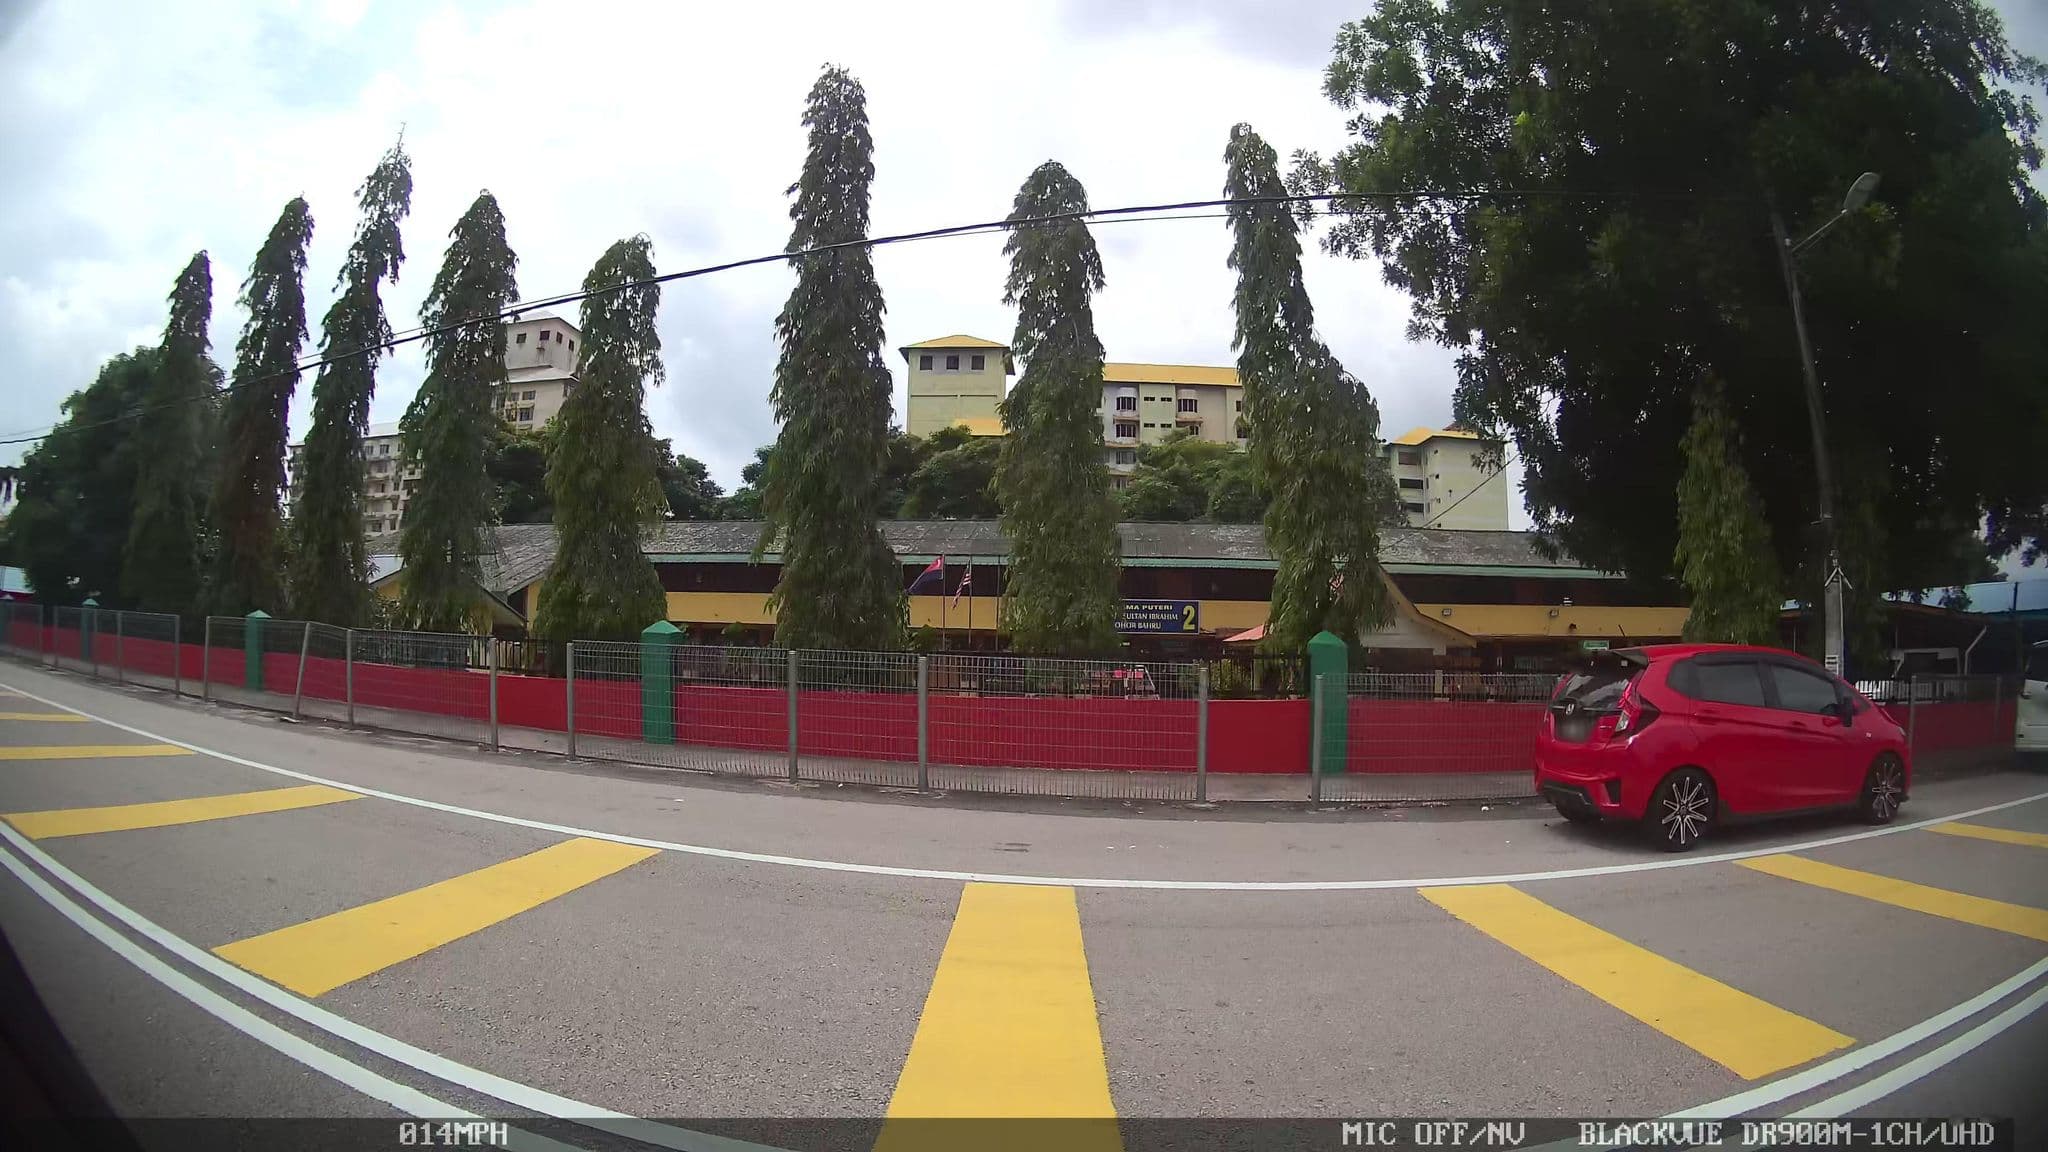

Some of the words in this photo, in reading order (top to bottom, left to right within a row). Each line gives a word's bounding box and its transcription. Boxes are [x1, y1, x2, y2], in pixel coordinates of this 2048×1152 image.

[1113, 621, 1136, 629] OHOR
[1138, 622, 1162, 630] BAHRU
[1182, 605, 1196, 631] 2
